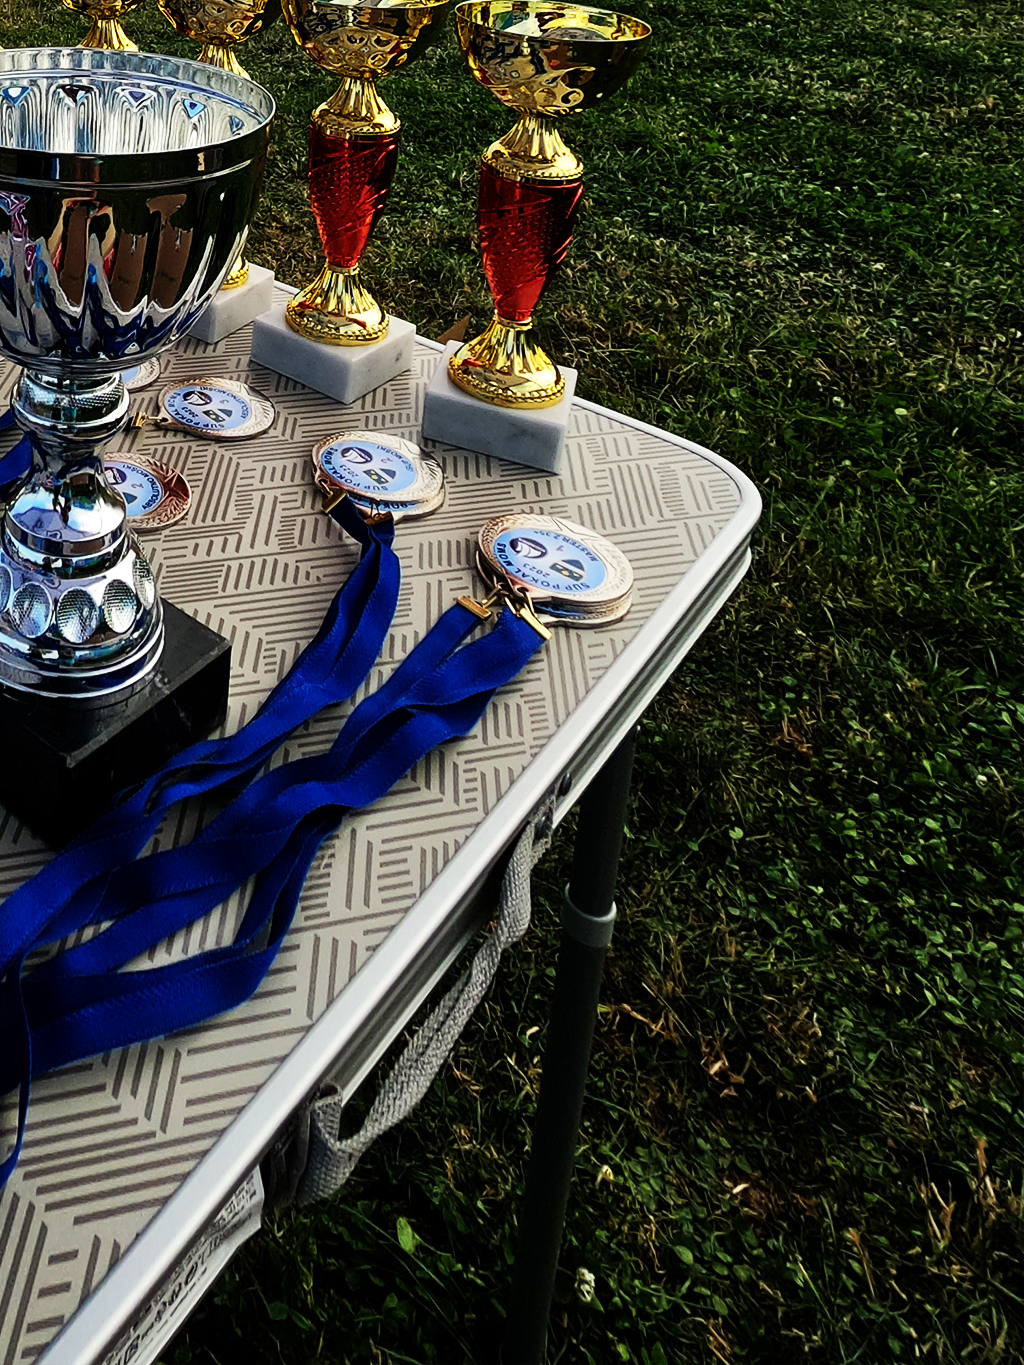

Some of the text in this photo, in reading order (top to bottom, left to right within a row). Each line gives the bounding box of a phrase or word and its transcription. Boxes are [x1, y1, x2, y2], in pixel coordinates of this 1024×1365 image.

[171, 409, 201, 427] POKAL
[328, 466, 361, 487] POKAL
[339, 465, 359, 477] 2023
[562, 536, 598, 562] MASTER
[514, 568, 560, 590] POKAL
[522, 563, 550, 577] 2023
[565, 583, 590, 591] SUP
